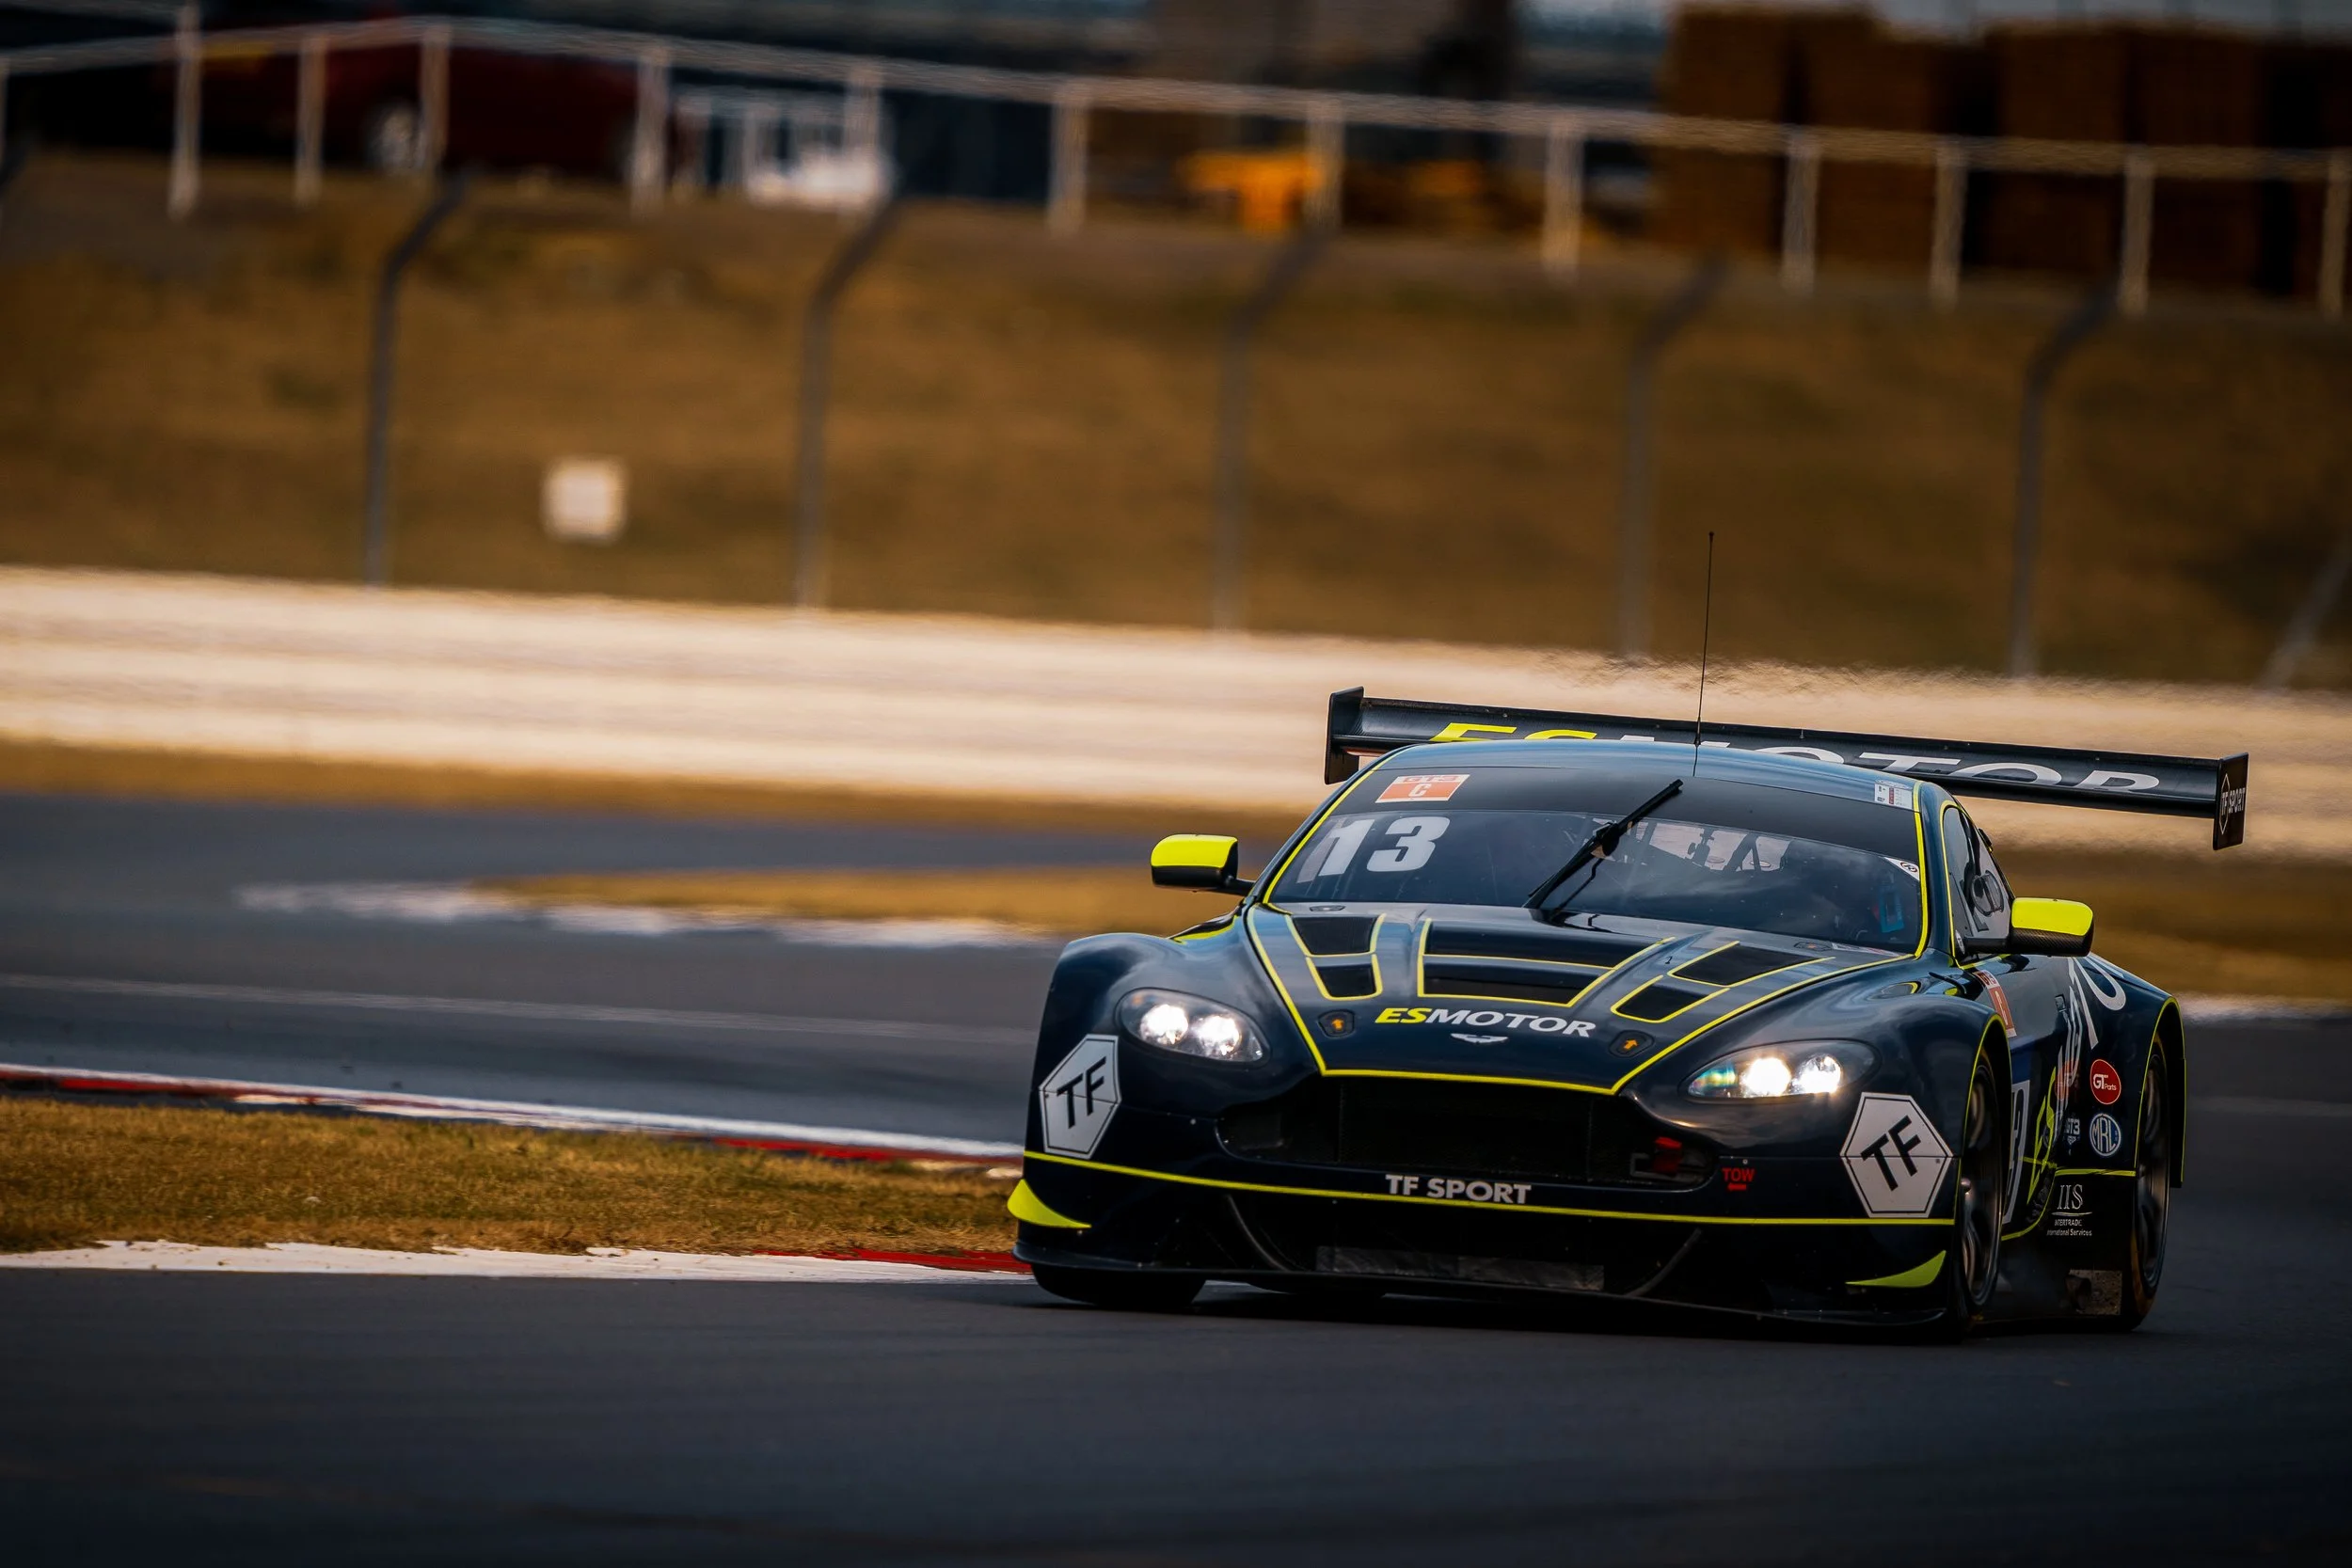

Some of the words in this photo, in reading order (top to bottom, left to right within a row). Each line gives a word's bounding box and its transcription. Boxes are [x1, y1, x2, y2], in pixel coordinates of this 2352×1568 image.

[1408, 783, 1432, 798] C
[2221, 791, 2229, 816] TF
[2229, 787, 2246, 815] SPORT
[1318, 816, 1450, 877] 13
[1375, 1007, 1596, 1037] ESMOTOR
[1056, 1055, 1106, 1129] TF
[2091, 1117, 2117, 1153] MRL
[1860, 1115, 1921, 1192] TF
[1385, 1174, 1419, 1196] TF
[1426, 1178, 1532, 1204] SPORT
[1722, 1167, 1755, 1182] TOW
[2057, 1183, 2083, 1210] IIS
[2070, 1228, 2092, 1237] Services
